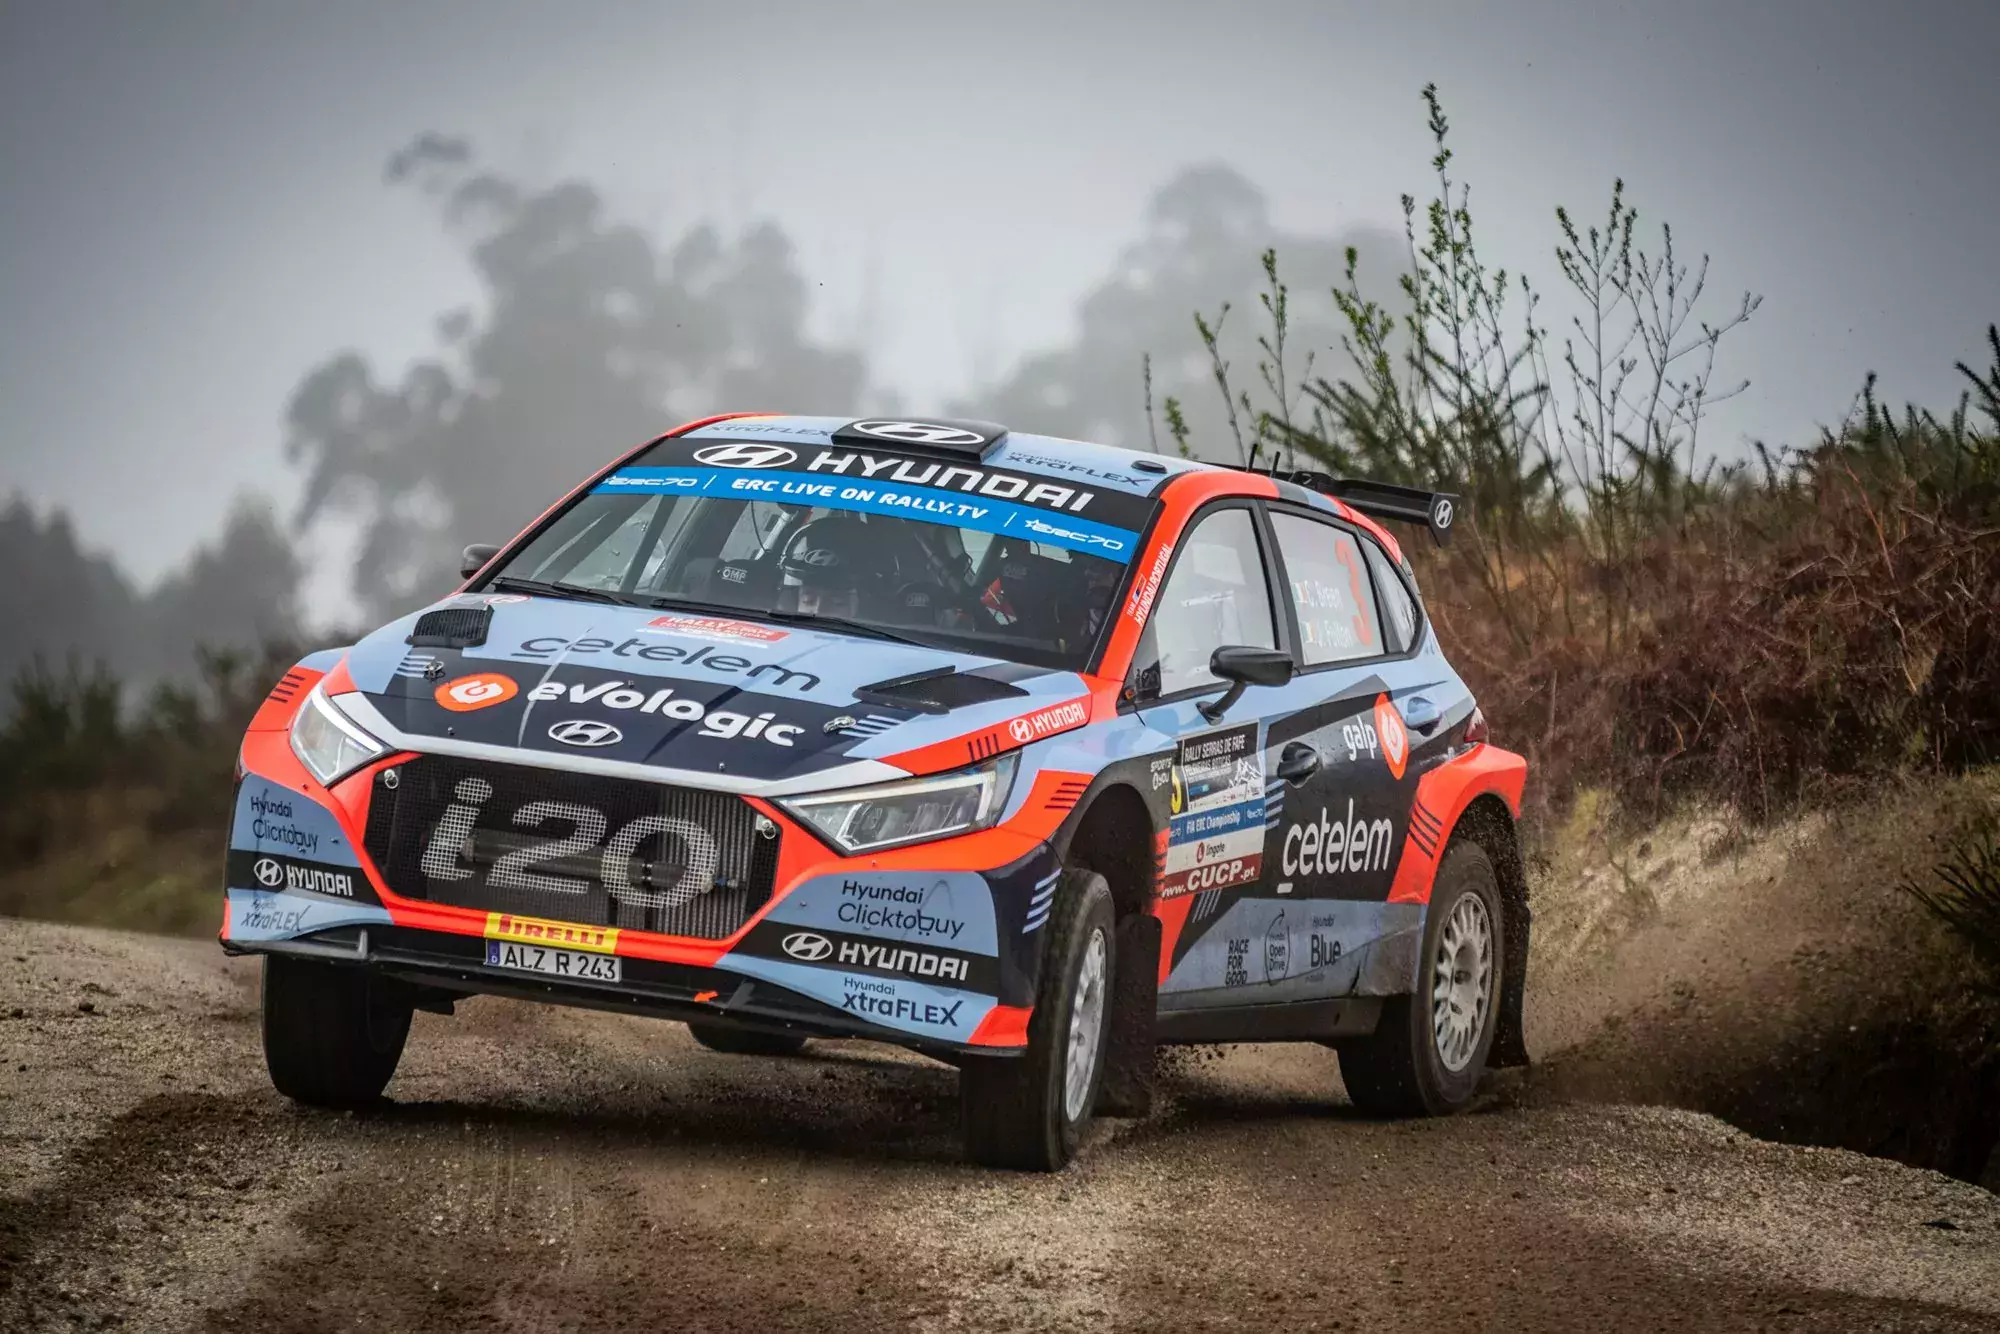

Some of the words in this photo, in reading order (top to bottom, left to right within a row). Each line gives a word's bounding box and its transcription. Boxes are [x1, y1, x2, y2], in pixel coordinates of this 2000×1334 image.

[807, 450, 1095, 512] HYUNDAI
[1006, 455, 1151, 487] xtraFLEX
[731, 478, 779, 492] ERC
[782, 481, 837, 498] LIVE
[840, 487, 876, 503] ON
[878, 493, 989, 520] RALLY.TV
[722, 567, 747, 581] OMP
[520, 637, 822, 692] cetelem
[527, 681, 806, 747] evologic
[1031, 703, 1087, 734] HYUNDAI
[1185, 745, 1202, 762] RALLY
[1202, 739, 1224, 759] SERRAS
[1224, 737, 1232, 753] DE
[1343, 715, 1377, 761] galp
[1150, 757, 1172, 773] SPORTS
[251, 796, 293, 818] Hyundai
[420, 777, 718, 909] i20
[1282, 798, 1393, 877] cetelem
[286, 864, 353, 896] HYUNDAI
[841, 880, 924, 904] Hyundai
[498, 915, 607, 946] PIRELLI
[838, 902, 965, 940] Clicktobuy
[838, 942, 969, 981] HYUNDAI
[1227, 955, 1243, 969] FOR
[1228, 938, 1250, 954] RACE
[1269, 943, 1286, 958] Open
[1311, 934, 1342, 968] Blue
[504, 946, 546, 971] ALZ
[556, 952, 570, 974] R
[577, 955, 616, 980] 243
[1225, 970, 1248, 986] GOOD
[844, 977, 896, 996] Hyundai
[841, 992, 964, 1028] xtraFLEX
